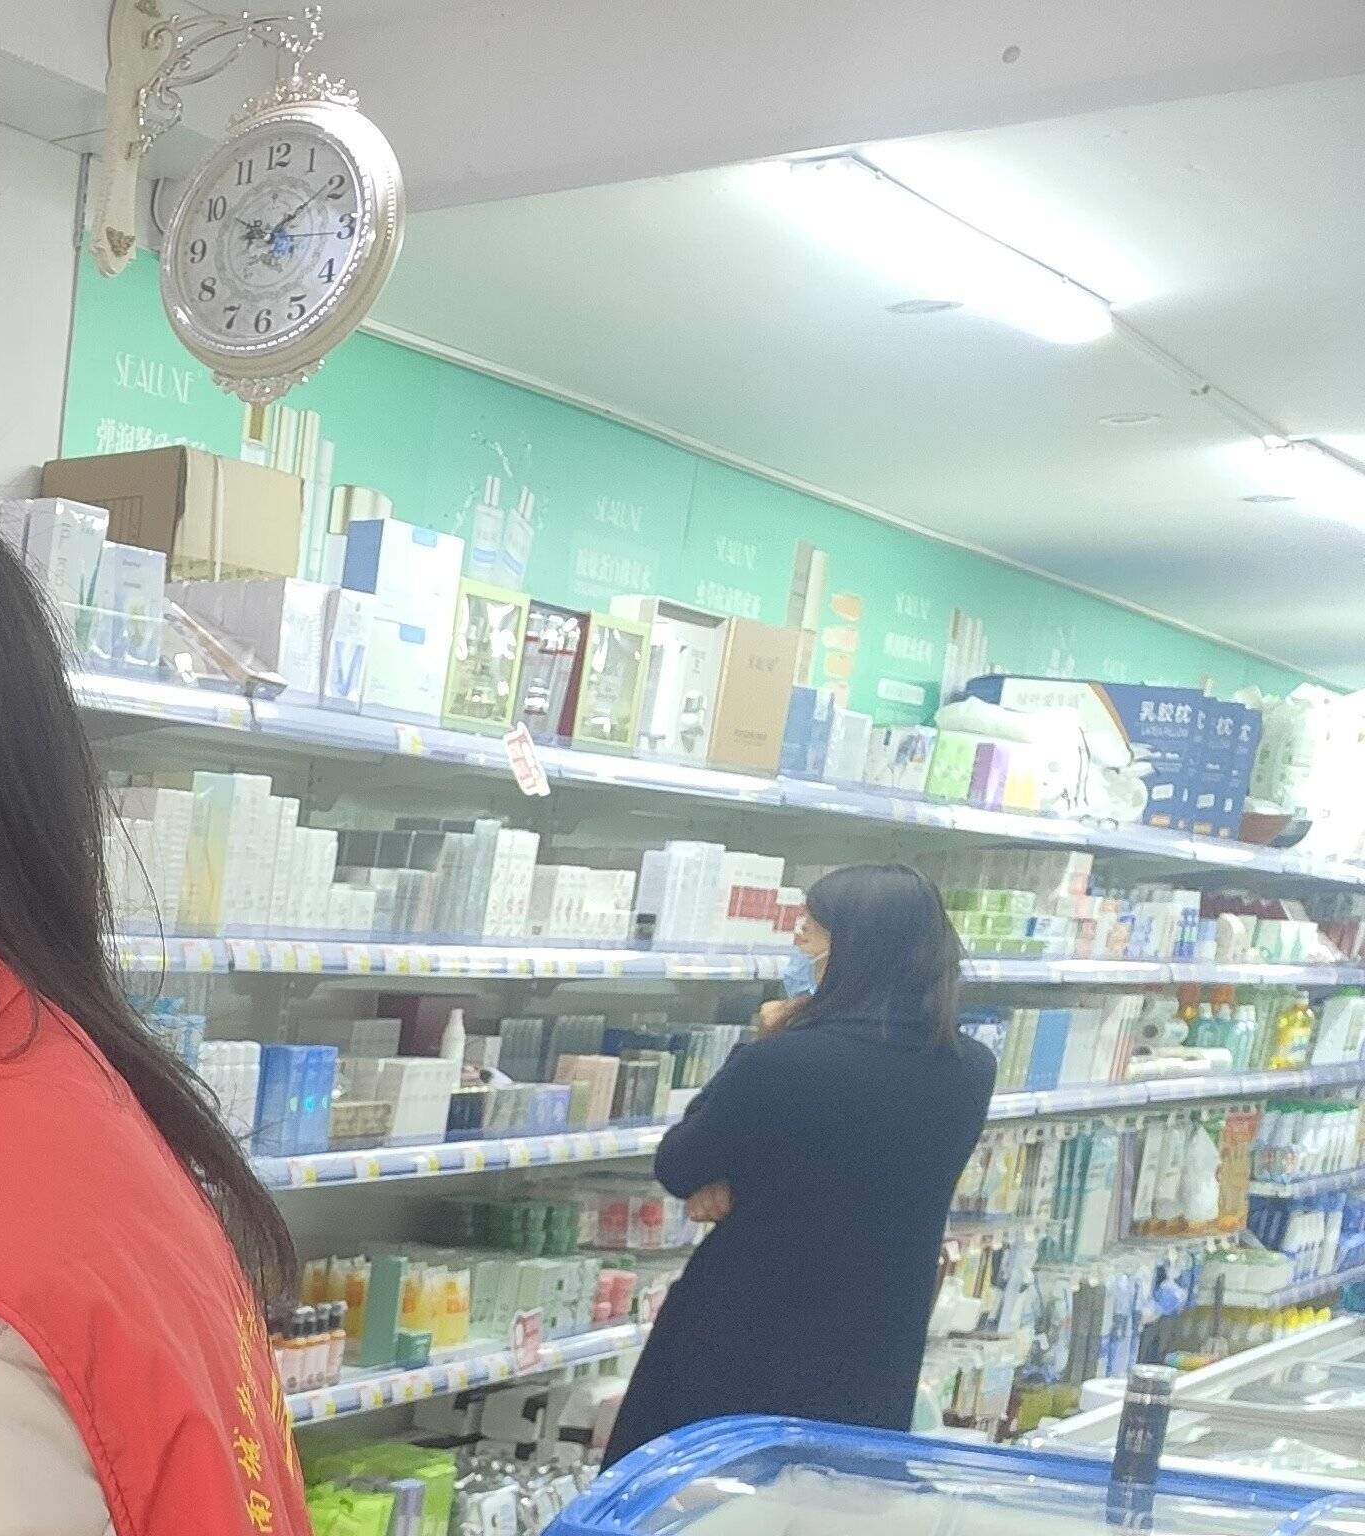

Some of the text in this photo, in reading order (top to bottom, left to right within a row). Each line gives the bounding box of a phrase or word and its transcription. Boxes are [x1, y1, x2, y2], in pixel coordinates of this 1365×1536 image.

[268, 142, 292, 172] 12
[307, 147, 316, 173] 1
[236, 159, 254, 186] 11
[327, 174, 345, 200] 2
[207, 196, 227, 223] 10
[336, 213, 355, 240] 3
[190, 239, 207, 264] 9
[318, 257, 336, 284] 4
[198, 276, 216, 301] 8
[223, 304, 242, 330] 7
[254, 308, 272, 334] 6
[286, 295, 307, 321] 5
